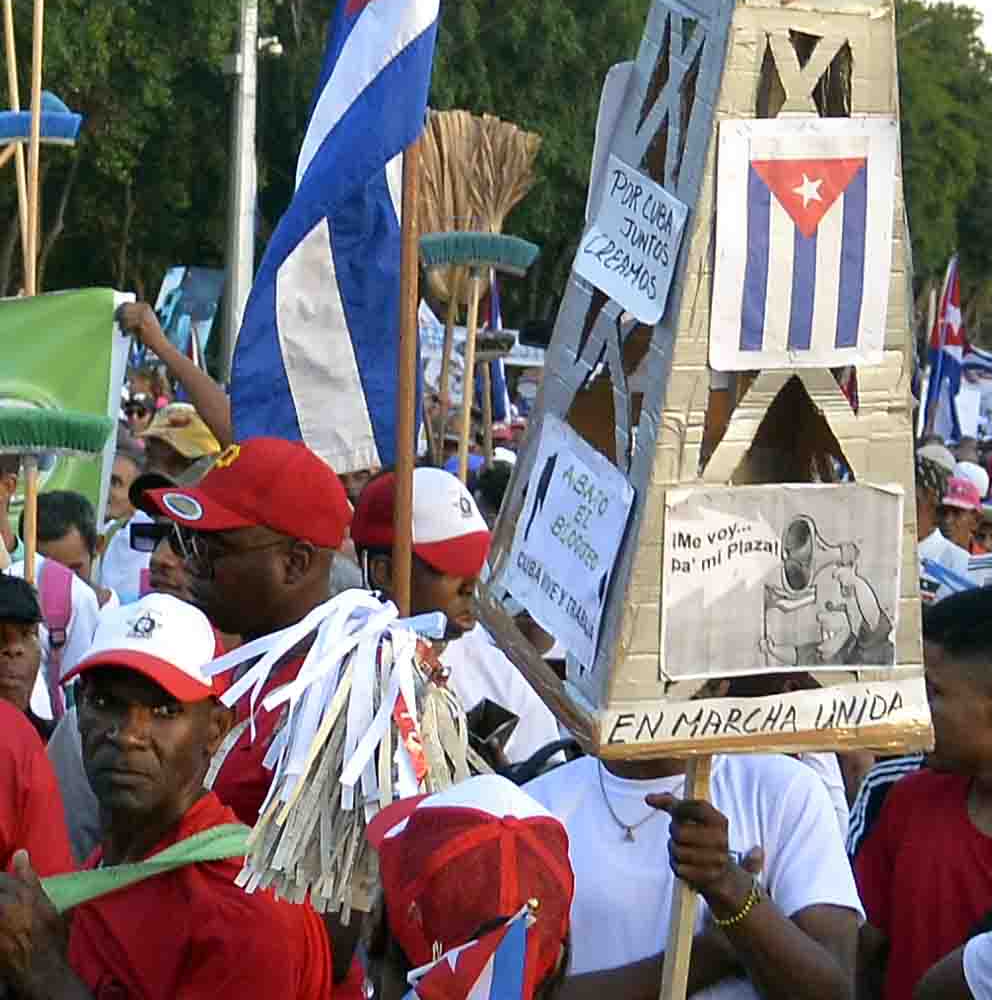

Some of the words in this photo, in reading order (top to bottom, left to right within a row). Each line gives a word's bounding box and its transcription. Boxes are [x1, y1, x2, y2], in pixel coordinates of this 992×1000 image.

[610, 170, 643, 213] POR
[642, 195, 674, 235] CUBA
[584, 233, 657, 300] CREAMOS
[620, 216, 669, 267] JUNTOS
[608, 711, 664, 744] EN
[671, 702, 798, 739] MARCHA
